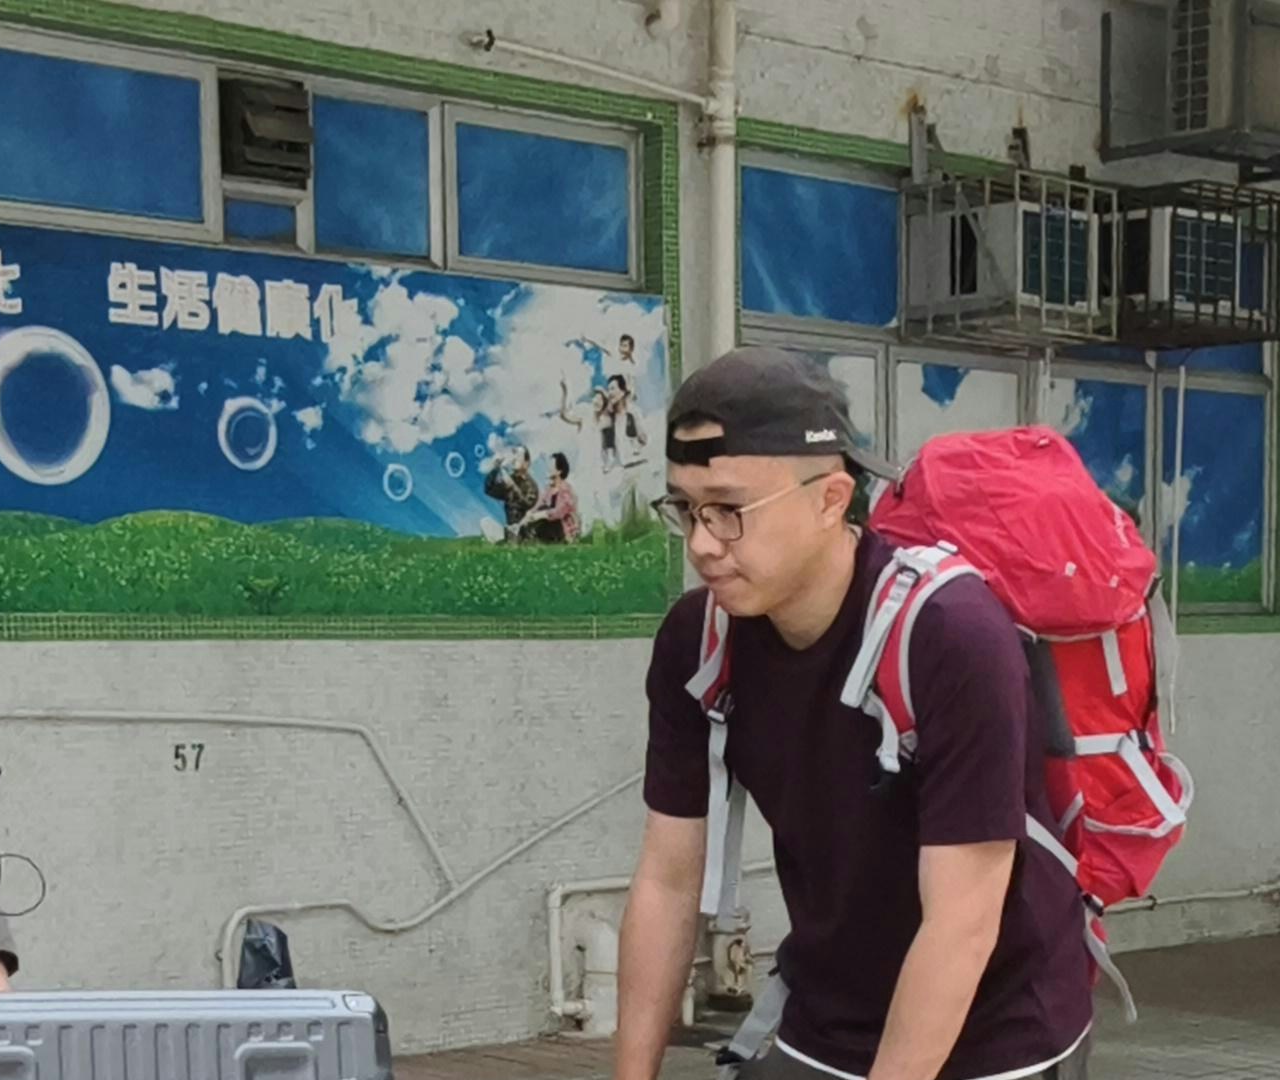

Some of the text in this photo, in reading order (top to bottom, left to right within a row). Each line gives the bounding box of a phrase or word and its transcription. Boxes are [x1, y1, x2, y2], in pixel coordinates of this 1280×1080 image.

[107, 261, 366, 345] 生活健康化
[174, 743, 205, 772] 57
